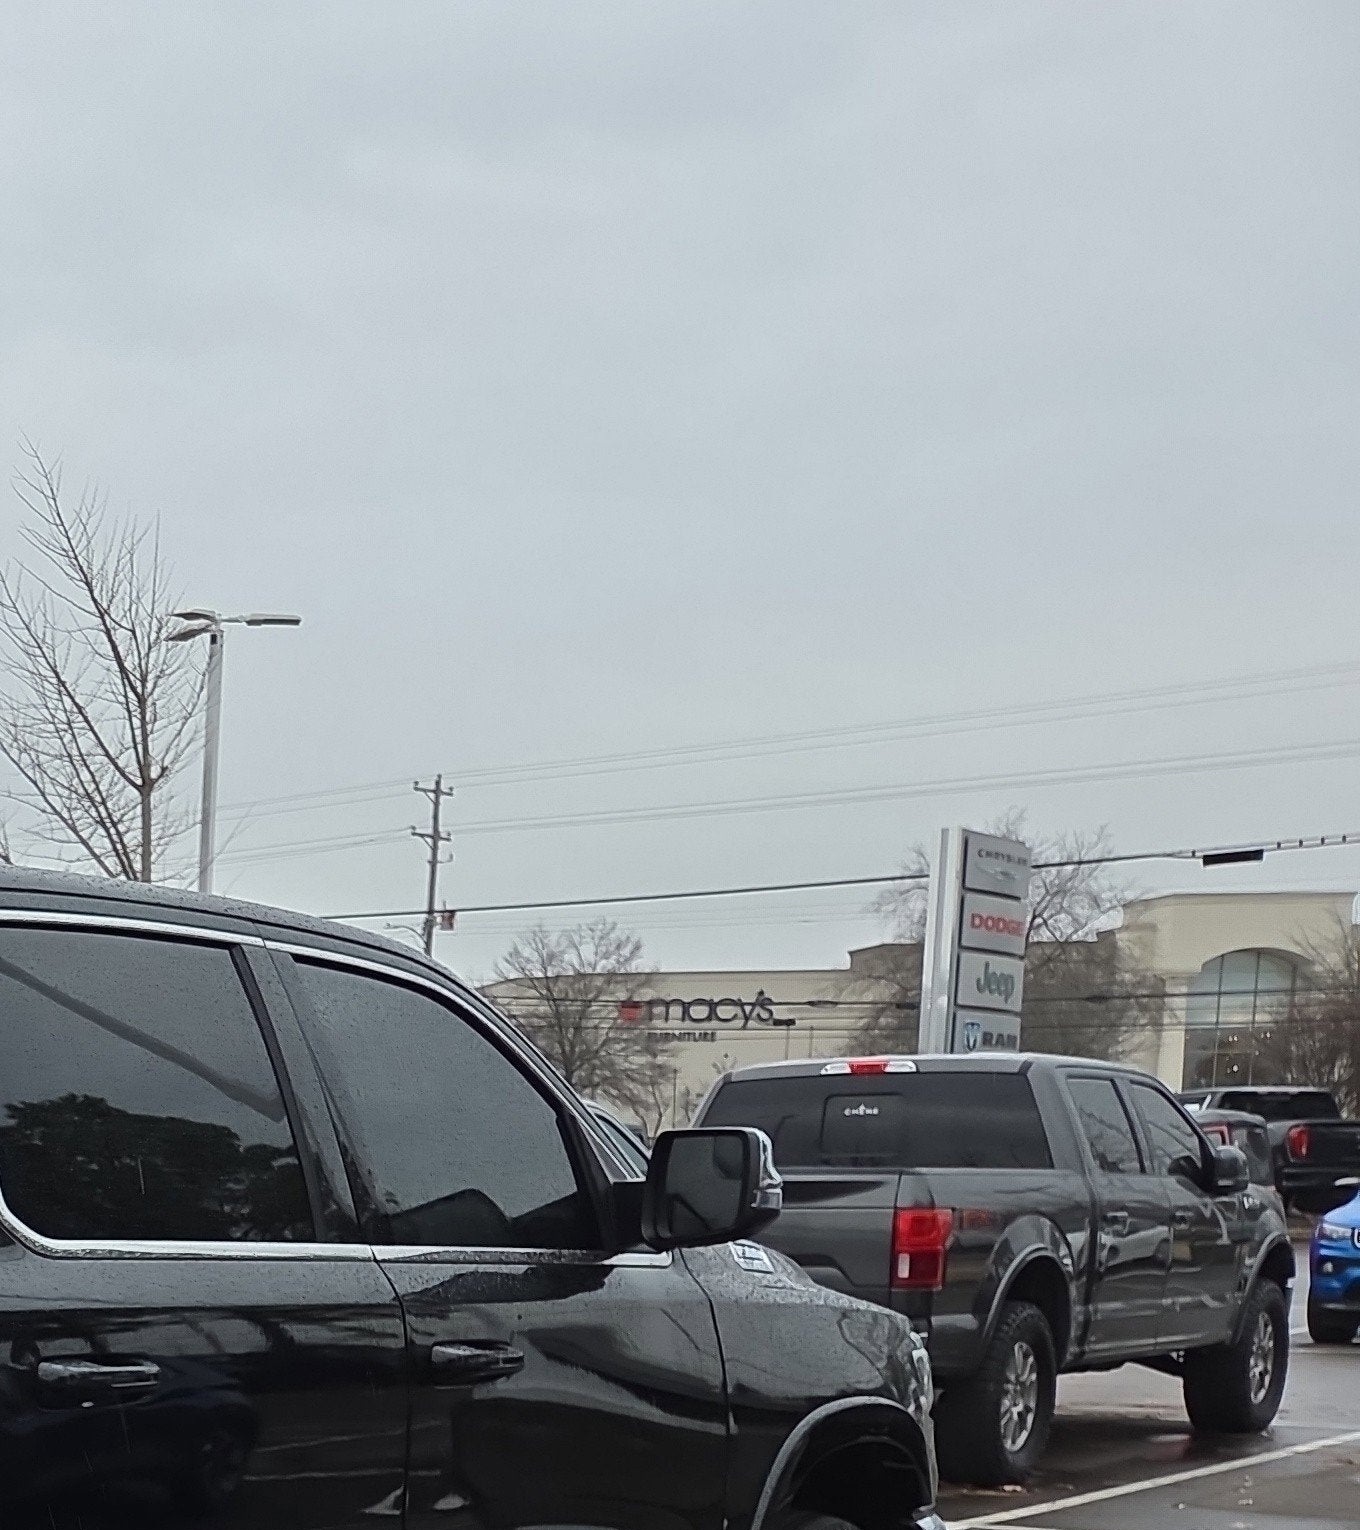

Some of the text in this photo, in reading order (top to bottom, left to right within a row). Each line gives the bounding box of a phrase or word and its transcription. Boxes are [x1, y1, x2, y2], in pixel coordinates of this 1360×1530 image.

[970, 912, 1025, 937] DODGE
[975, 960, 1016, 1004] Jeep
[647, 987, 775, 1030] macy's
[981, 1030, 1018, 1050] RAM
